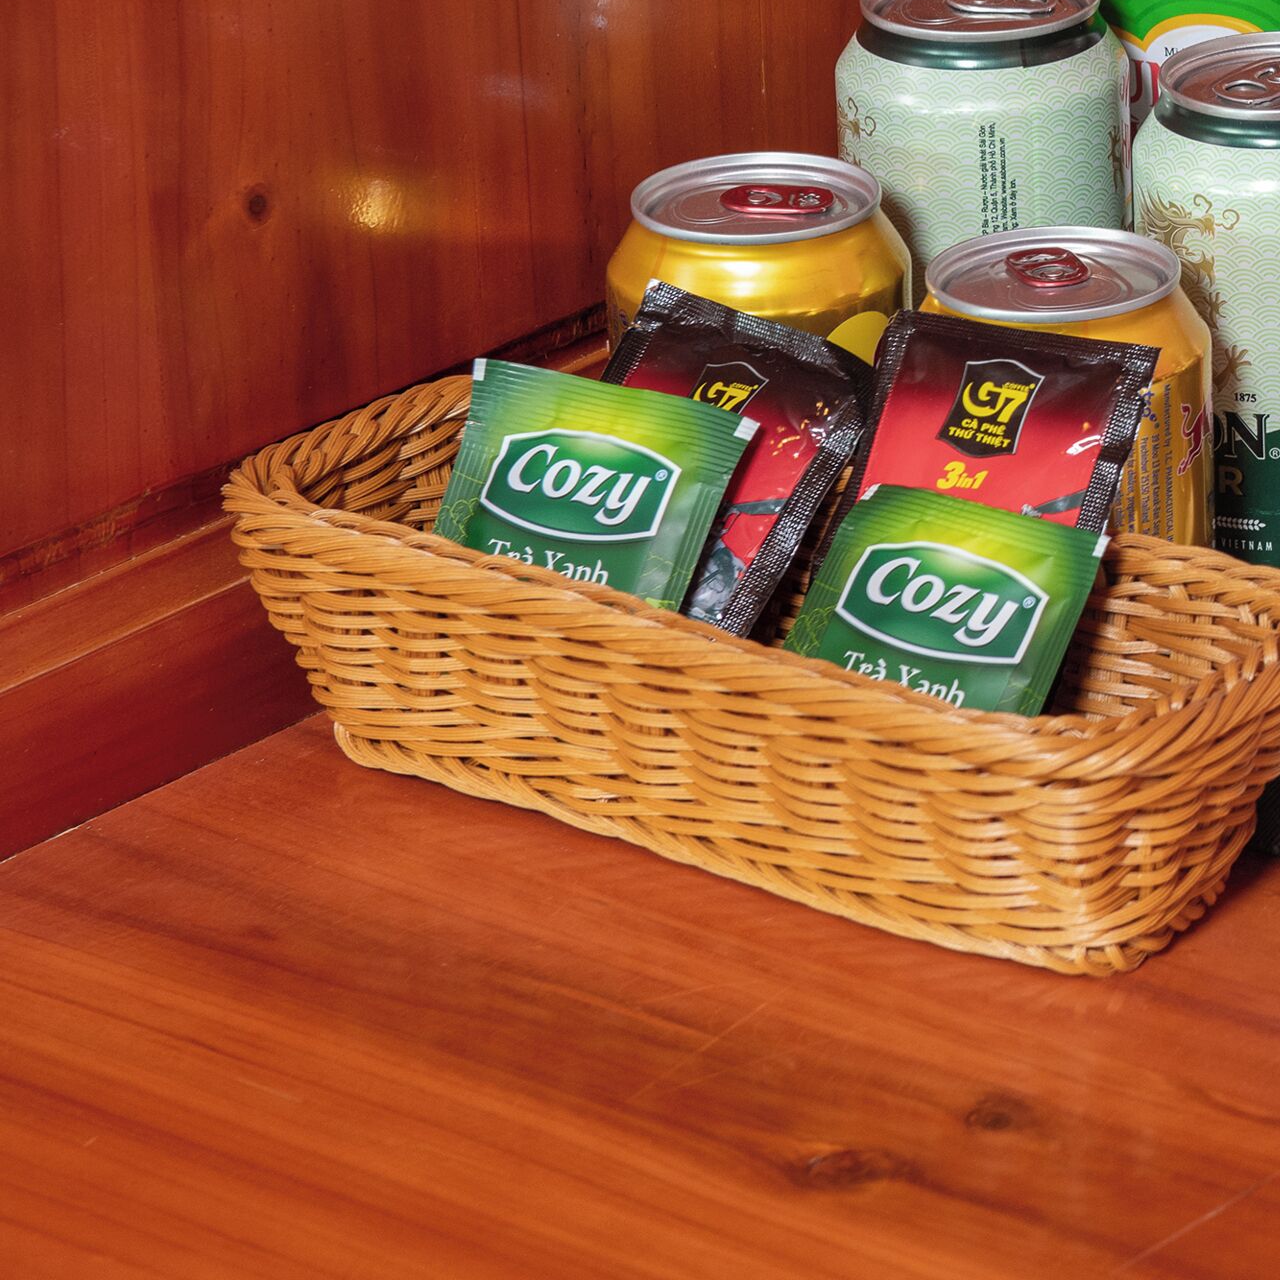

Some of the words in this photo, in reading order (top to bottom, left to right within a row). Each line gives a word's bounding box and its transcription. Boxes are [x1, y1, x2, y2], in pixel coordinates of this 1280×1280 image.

[978, 125, 986, 138] Gòn
[999, 138, 1007, 194] www.sabeco.com.vn
[961, 381, 1030, 423] G7
[1164, 384, 1172, 437] Manufactured
[1234, 392, 1257, 403] 1875
[948, 426, 975, 440] THỨ
[975, 431, 1011, 448] THIỆT
[961, 417, 979, 430] CÀ
[980, 422, 1007, 435] PHÊ
[1163, 438, 1171, 448] by
[507, 443, 652, 526] Cozy
[936, 460, 989, 490] 3in1
[1165, 466, 1174, 533] PHARMACEUTICAL
[866, 557, 1020, 647] Cozy
[898, 664, 966, 709] Xanh
